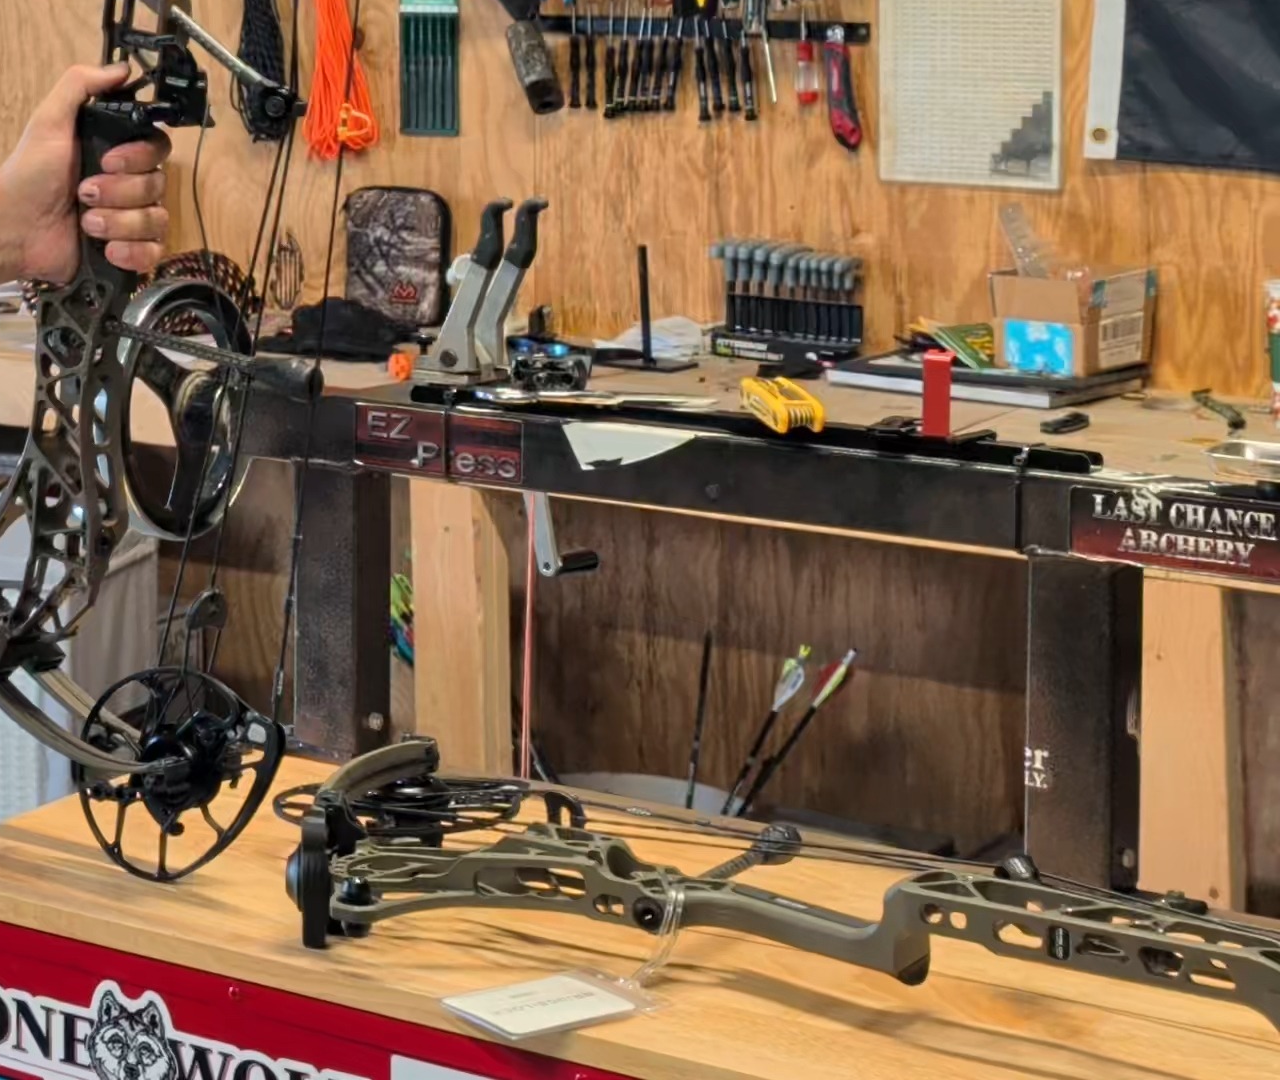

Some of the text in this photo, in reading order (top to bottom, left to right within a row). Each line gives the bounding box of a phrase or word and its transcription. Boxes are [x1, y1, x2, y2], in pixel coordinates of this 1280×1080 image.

[367, 409, 413, 441] EZ
[416, 440, 517, 479] Pess
[1092, 492, 1279, 541] LAST CHANCE
[1117, 526, 1256, 567] ARCHERY
